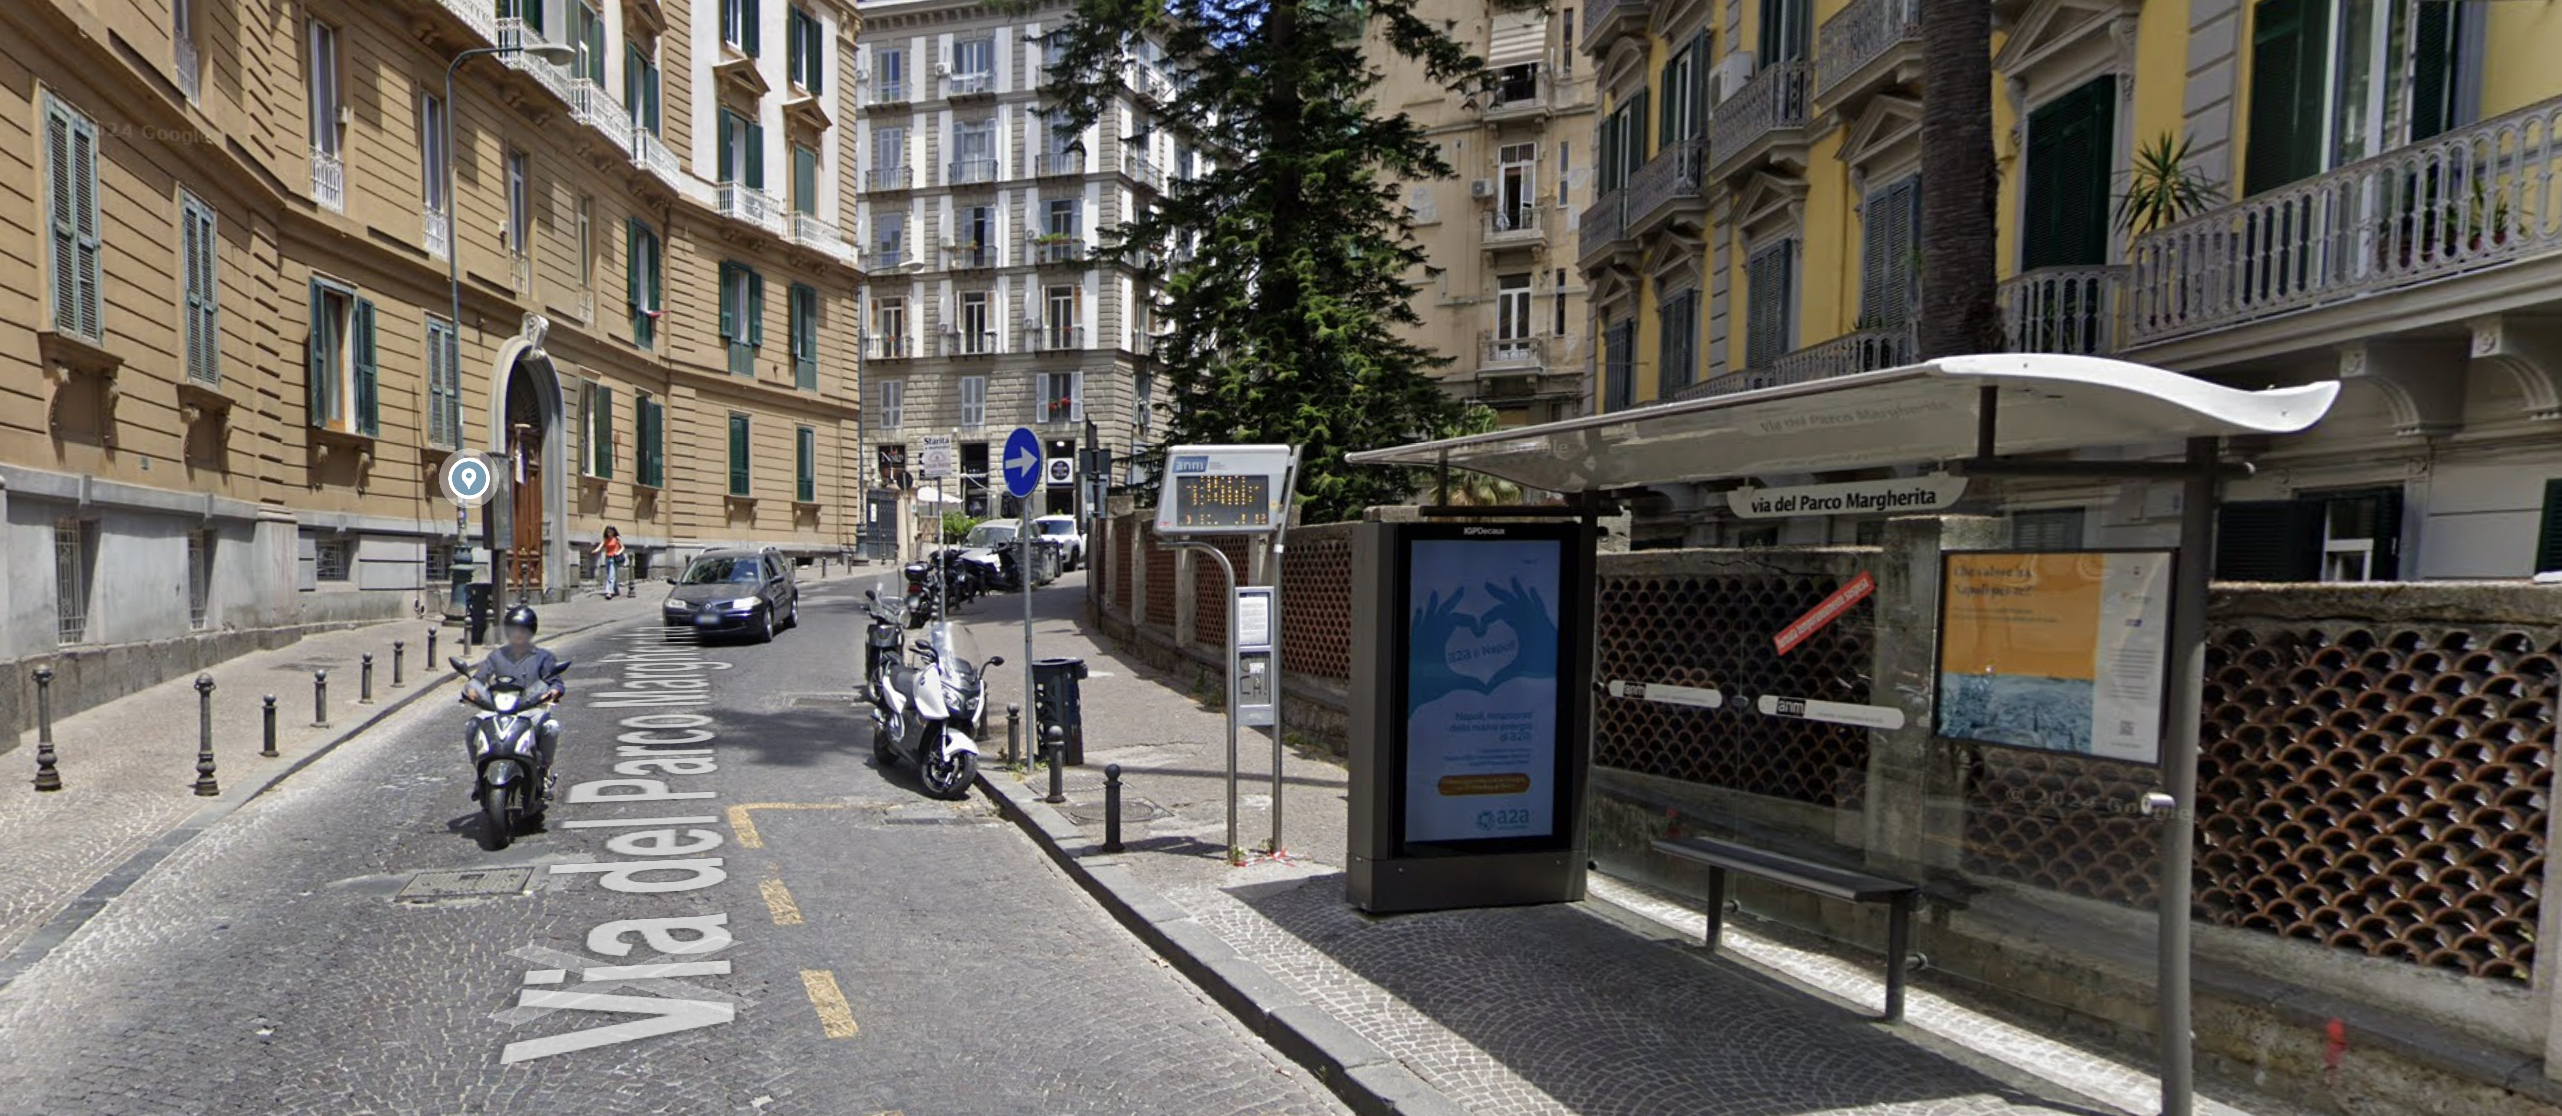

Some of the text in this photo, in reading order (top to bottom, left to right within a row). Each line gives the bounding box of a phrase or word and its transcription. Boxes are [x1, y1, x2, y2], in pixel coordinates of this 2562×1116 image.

[1176, 460, 1204, 471] anm
[1751, 487, 1936, 513] via del Parco Margherita
[1777, 700, 1805, 714] anm
[1497, 808, 1530, 824] a2a
